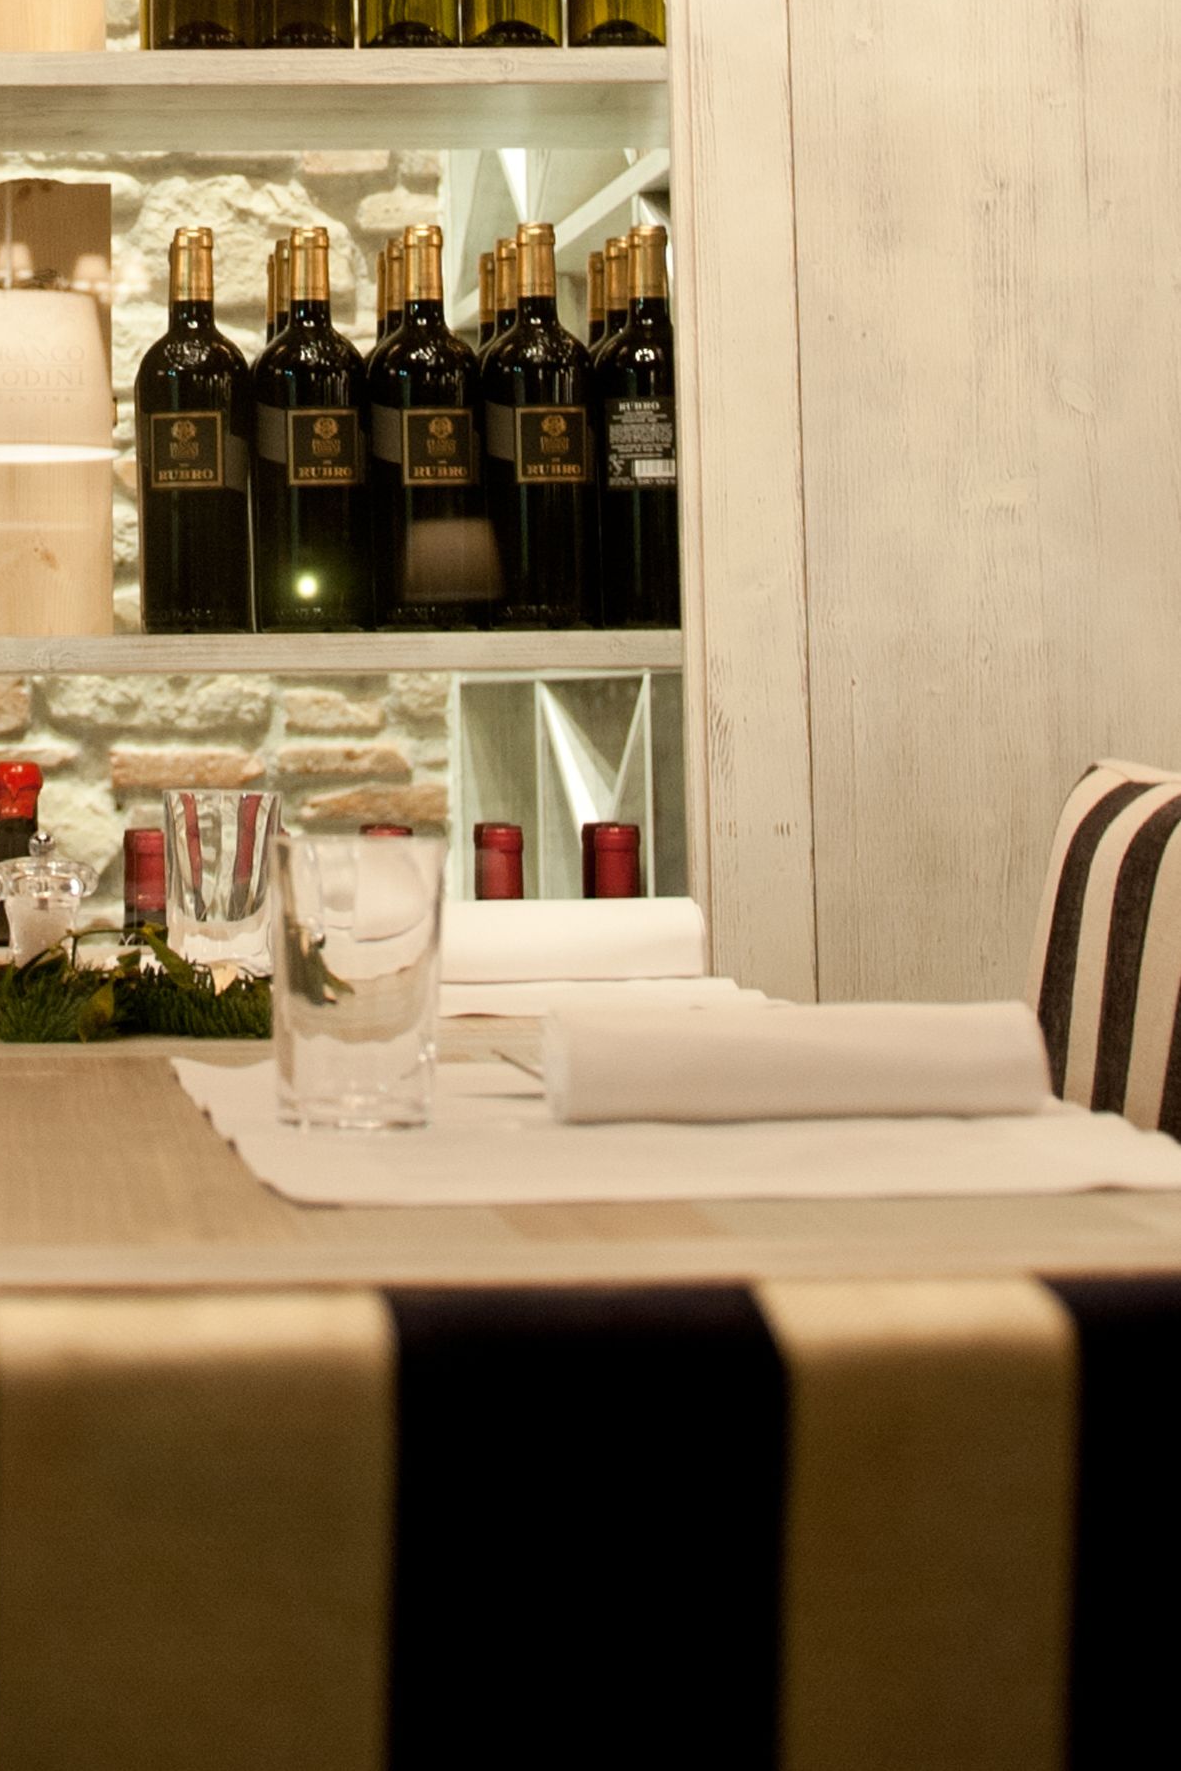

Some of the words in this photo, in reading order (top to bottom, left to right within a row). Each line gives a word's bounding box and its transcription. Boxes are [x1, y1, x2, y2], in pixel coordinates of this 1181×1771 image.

[157, 469, 214, 481] RUBRO
[298, 467, 352, 479] RUBRO
[413, 466, 467, 478] RUBRO
[527, 464, 581, 475] RUBRO
